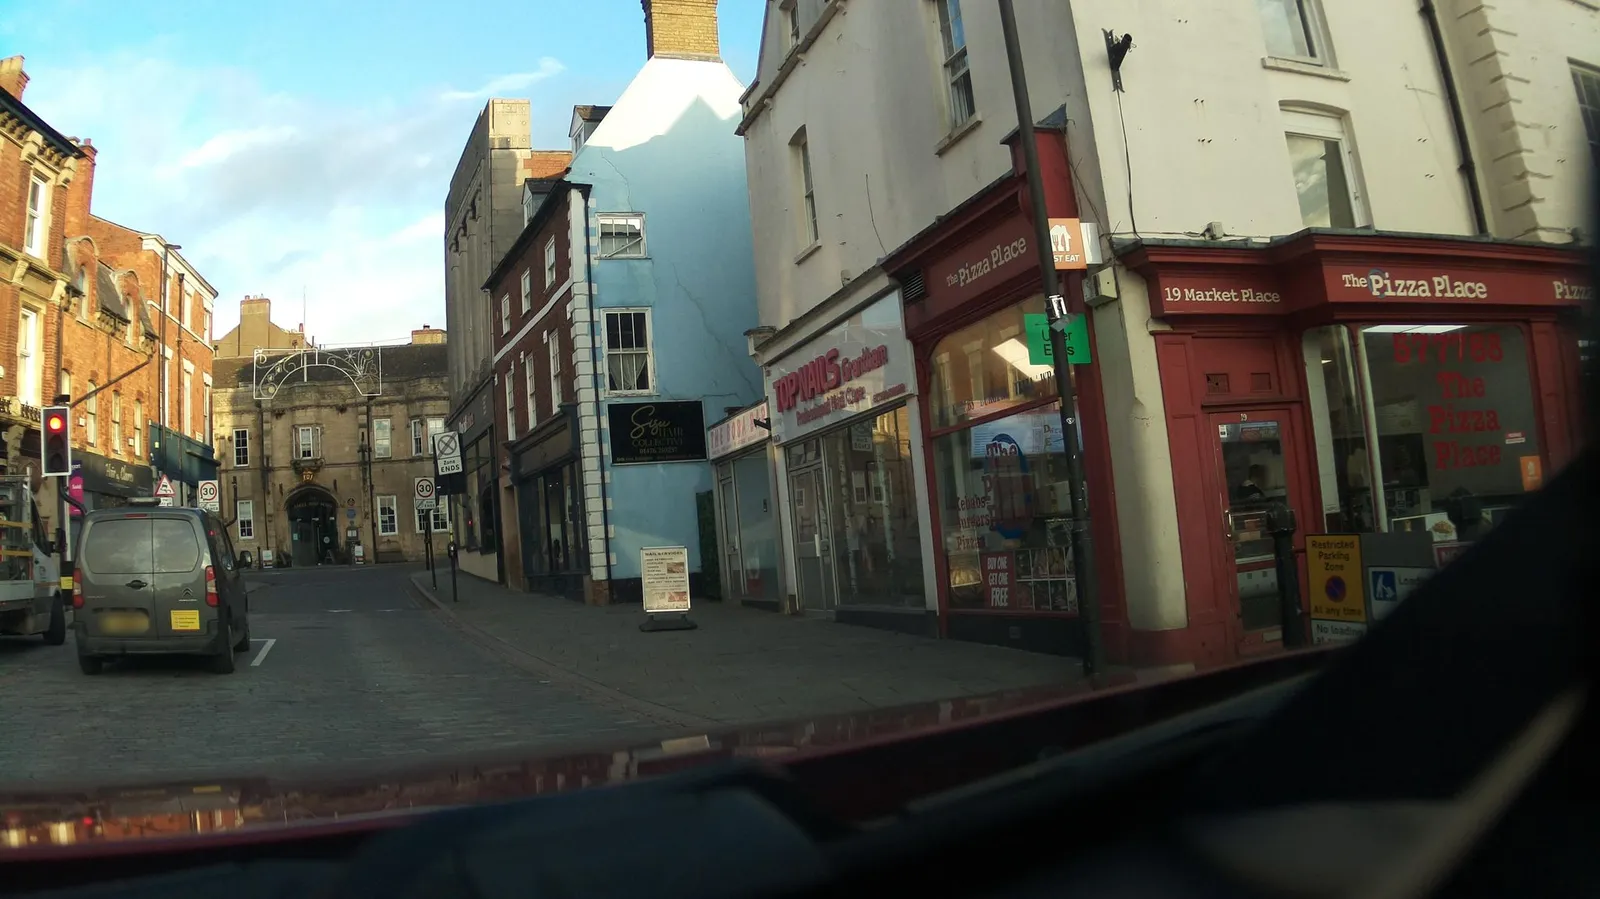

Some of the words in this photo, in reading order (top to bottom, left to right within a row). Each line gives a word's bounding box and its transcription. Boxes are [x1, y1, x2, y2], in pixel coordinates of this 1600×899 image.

[946, 273, 959, 287] The
[958, 262, 991, 287] Pizza
[990, 237, 1027, 269] Place
[1065, 254, 1080, 263] EAT
[1342, 273, 1368, 287] The
[1369, 272, 1432, 297] Pizza
[1432, 275, 1488, 299] Place
[1164, 287, 1182, 302] 19
[1183, 287, 1239, 302] Market
[1240, 288, 1281, 303] Place
[1041, 329, 1073, 342] Uer
[1043, 344, 1075, 357] Es
[773, 371, 800, 413] TOP
[797, 348, 842, 402] NAILS
[841, 345, 889, 382] Grantham
[1436, 371, 1486, 399] The
[1427, 402, 1502, 435] Pizza
[1433, 440, 1501, 470] Place
[440, 464, 460, 473] ENDS
[203, 487, 215, 496] 30
[418, 484, 431, 493] 30
[1311, 540, 1355, 549] Restricted
[987, 557, 997, 570] BUY
[997, 556, 1008, 570] ONE
[1318, 551, 1350, 562] Parking
[1324, 562, 1344, 571] Zone
[988, 572, 998, 586] GET
[998, 572, 1009, 586] ONE
[991, 587, 1009, 607] FREE
[1313, 605, 1324, 614] At
[1325, 607, 1341, 617] any
[1343, 607, 1362, 616] time
[1316, 624, 1328, 634] No
[1330, 624, 1363, 637] loadin
